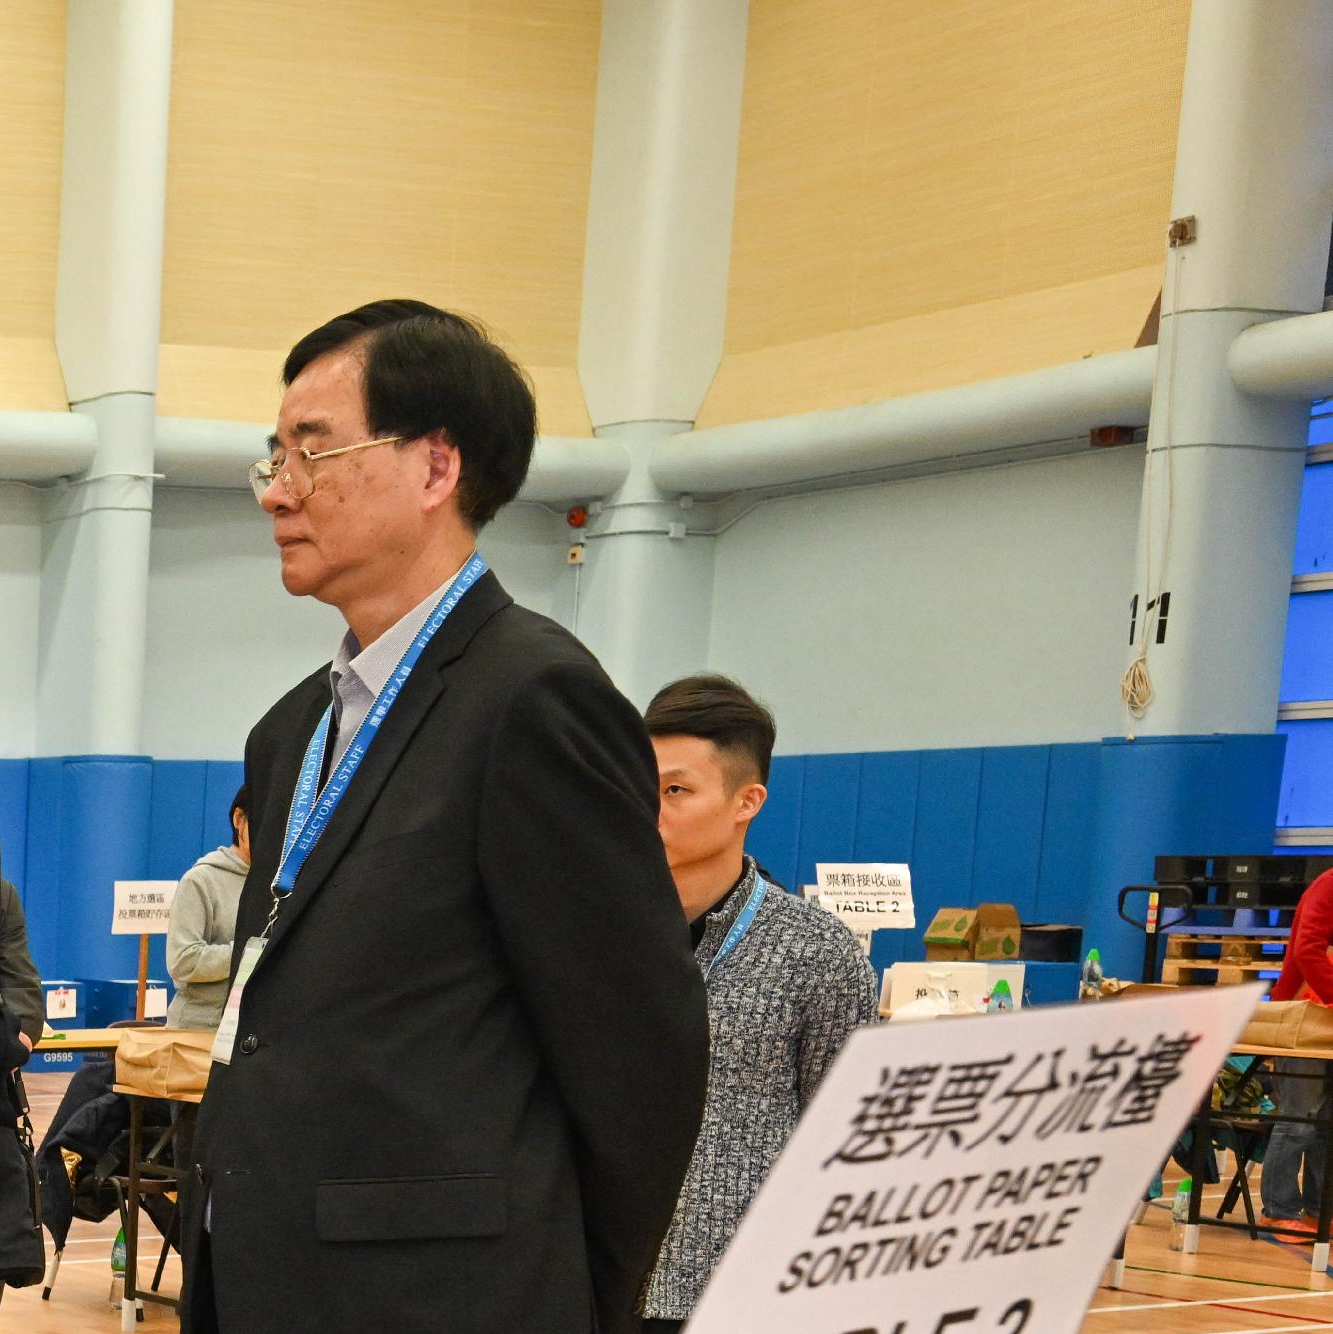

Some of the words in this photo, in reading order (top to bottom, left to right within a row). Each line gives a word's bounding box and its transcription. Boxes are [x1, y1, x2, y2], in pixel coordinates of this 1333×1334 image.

[298, 740, 320, 807] ELECTORAL
[299, 784, 342, 851] ELECTORAL
[339, 744, 364, 783] STAFF
[836, 901, 886, 912] TABLE
[892, 901, 900, 912] 2
[44, 1053, 73, 1062] G9595
[814, 1172, 981, 1241] BALLOT
[985, 1156, 1101, 1211] PAPER
[778, 1228, 957, 1294] SORTING
[960, 1206, 1081, 1263] TABLE
